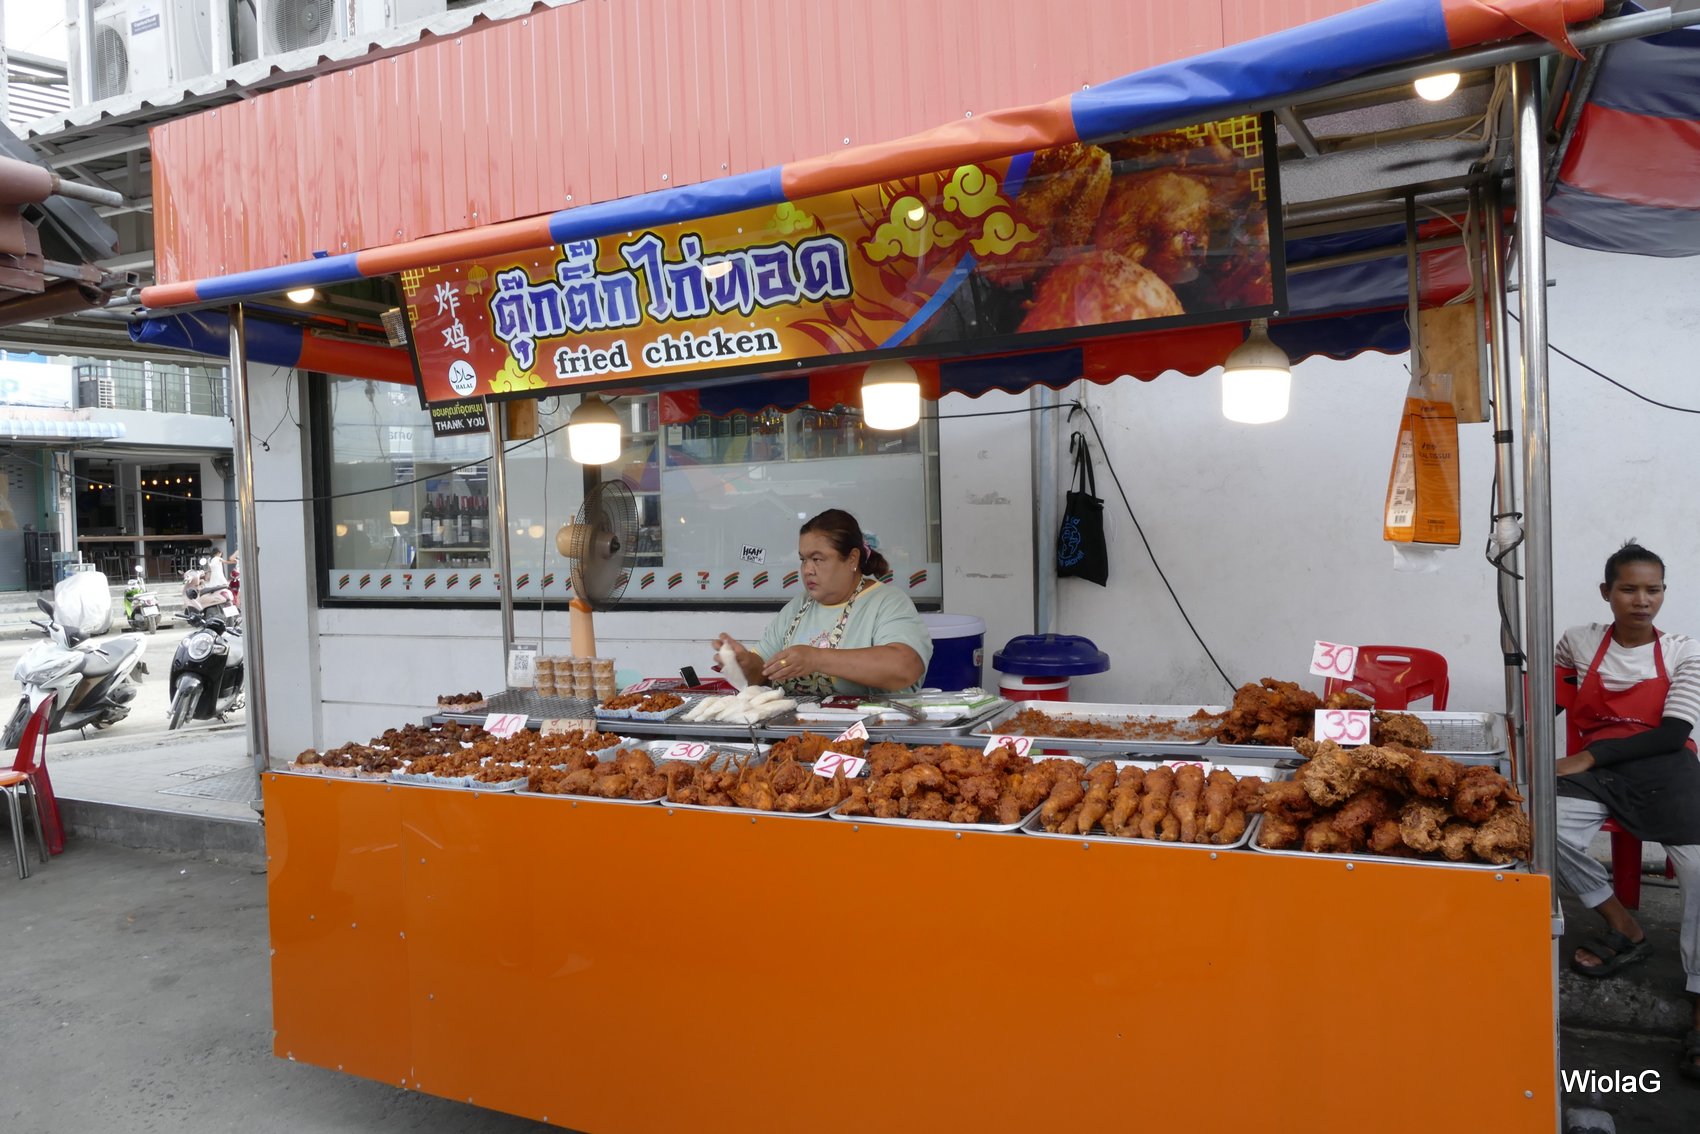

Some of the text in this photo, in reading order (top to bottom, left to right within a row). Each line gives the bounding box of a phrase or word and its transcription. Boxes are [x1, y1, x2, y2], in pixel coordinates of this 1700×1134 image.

[433, 281, 471, 354] 炸鸡
[556, 331, 778, 375] fried chicken
[450, 366, 475, 384] حلال
[432, 401, 484, 418] ขอบคุณที่อุดหนุน
[435, 416, 486, 431] THANK YOU
[1314, 642, 1354, 675] 30
[1323, 710, 1371, 741] 35
[670, 743, 705, 758] 30
[816, 753, 858, 775] 20
